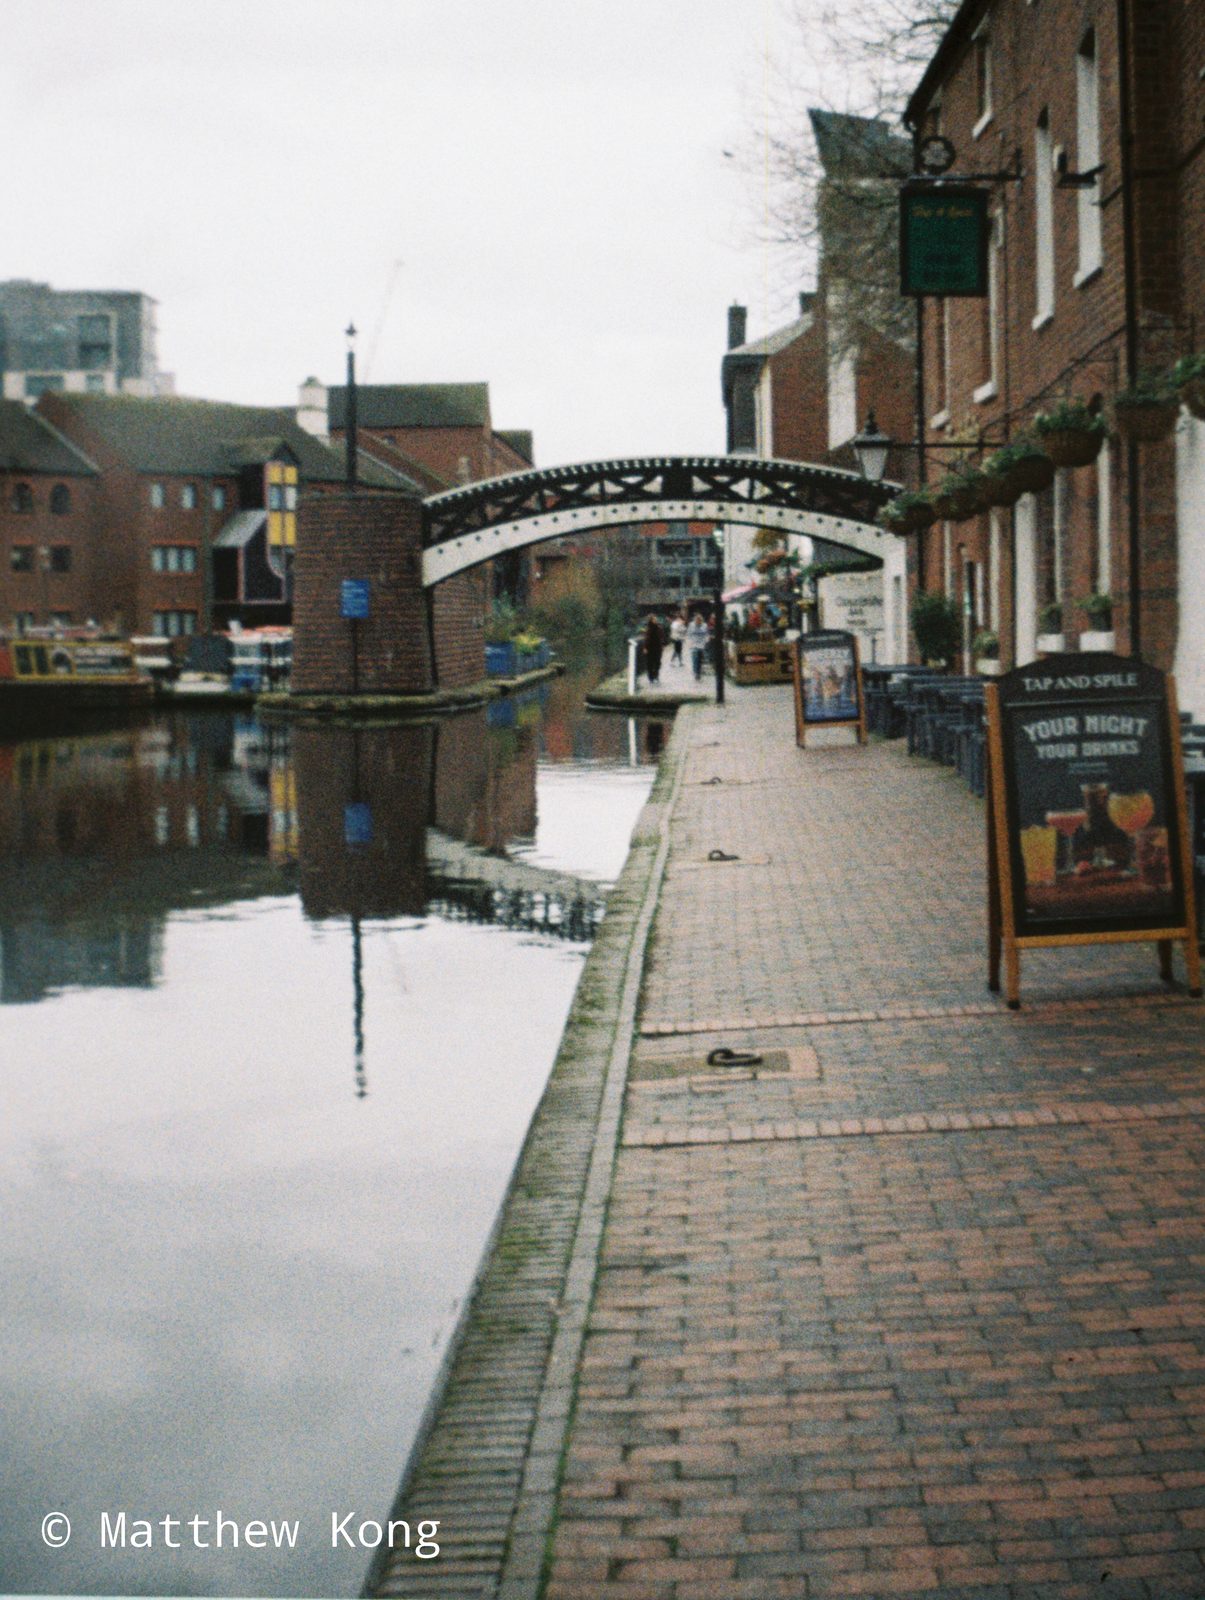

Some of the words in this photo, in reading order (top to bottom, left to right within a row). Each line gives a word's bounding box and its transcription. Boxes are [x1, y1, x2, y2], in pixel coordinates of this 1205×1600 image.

[1023, 677, 1053, 690] TAP
[1055, 676, 1091, 689] AND
[1093, 673, 1137, 687] SPILE
[1022, 716, 1079, 742] YOUR
[1085, 715, 1148, 737] NIGHT
[1036, 743, 1078, 759] YOUR
[1082, 740, 1139, 756] DRINKS
